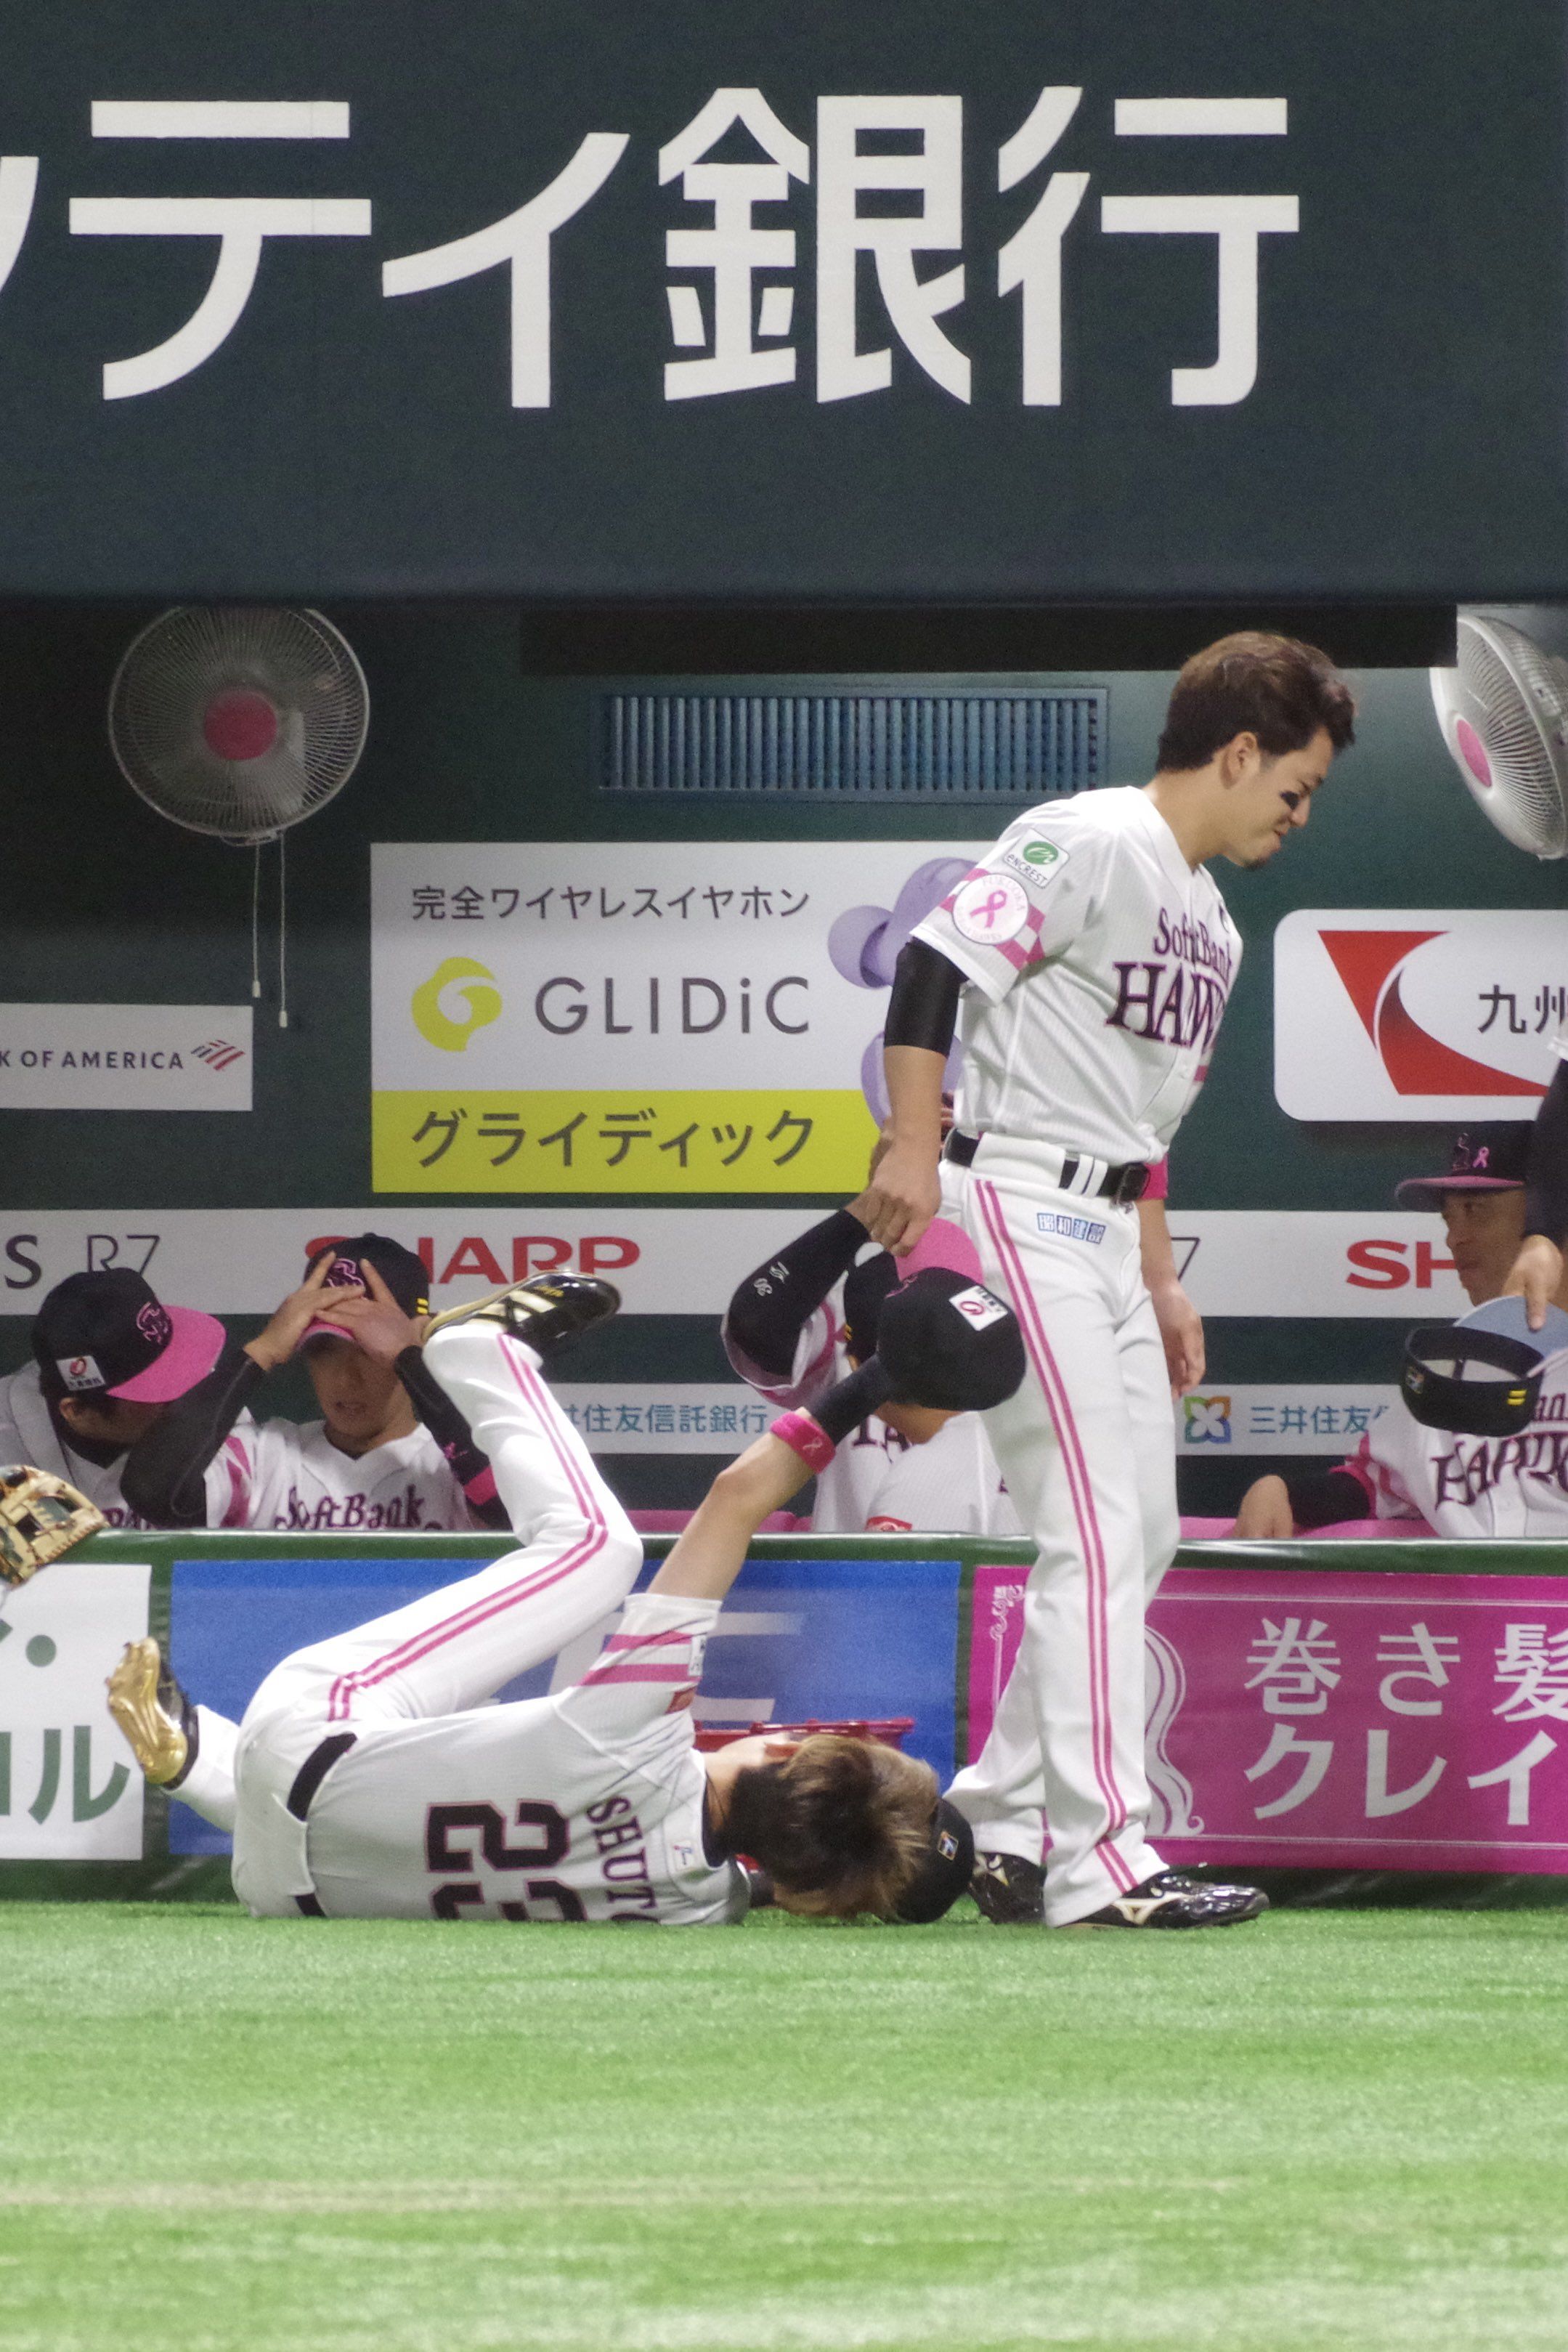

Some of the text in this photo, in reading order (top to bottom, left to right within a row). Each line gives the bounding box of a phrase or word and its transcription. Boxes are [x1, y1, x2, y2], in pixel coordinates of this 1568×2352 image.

[412, 885, 810, 920] 完全ワイヤレスイヤホン
[534, 976, 809, 1035] GLIDiC
[1105, 961, 1226, 1056] HAW
[20, 1050, 54, 1068] OF
[61, 1052, 184, 1069] AMERICA
[411, 1106, 813, 1168] グライディック
[4, 1234, 42, 1289] S
[1249, 1406, 1390, 1435] 三井住友
[1244, 1617, 1568, 1723] 巻き髪
[1244, 1724, 1558, 1833] クレイ
